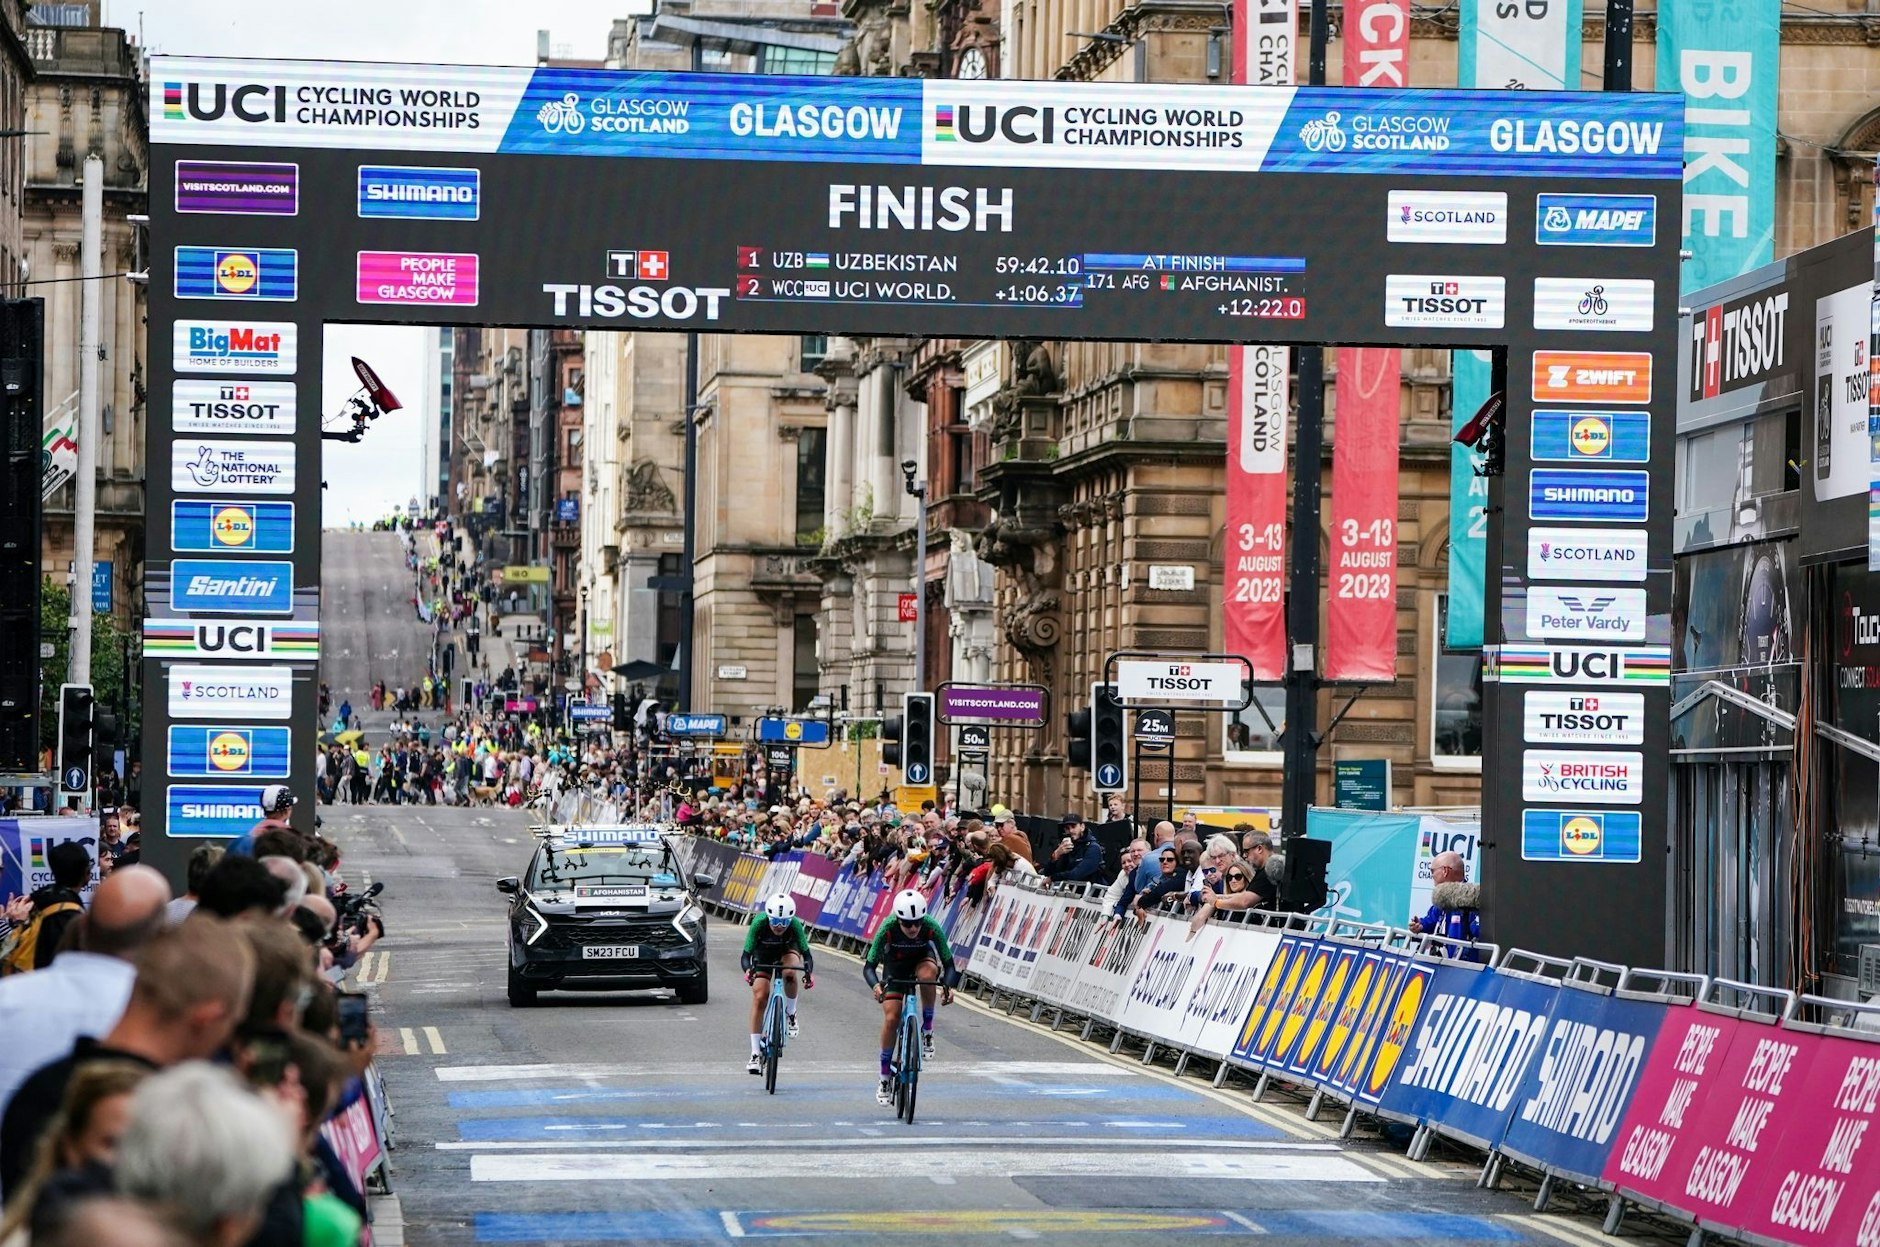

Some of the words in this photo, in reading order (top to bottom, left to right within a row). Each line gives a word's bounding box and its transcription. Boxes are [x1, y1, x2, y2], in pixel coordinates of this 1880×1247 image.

[188, 84, 285, 122] UCI
[297, 86, 392, 106] CYCLING
[401, 90, 480, 108] WORLD
[591, 98, 689, 117] GLASGOW
[1064, 108, 1158, 125] CYCLING
[1165, 110, 1244, 126] WORLD
[297, 107, 480, 129] CHAMPIONSHIPS
[590, 116, 689, 134] SCOTLAND
[730, 103, 902, 140] GLASGOW
[958, 106, 1054, 144] UCI
[1353, 115, 1450, 134] GLASGOW
[1064, 128, 1243, 148] CHAMPIONSHIPS
[1352, 133, 1450, 151] SCOTLAND
[1490, 120, 1664, 155] GLASGOW
[1681, 50, 1752, 238] BIKE
[182, 182, 290, 194] VISITSCOTLAND.COM
[367, 184, 473, 204] SHIMANO
[828, 184, 1012, 232] FINISH
[1414, 210, 1496, 224] SCOTLAND
[1575, 210, 1642, 230] MAPEI
[400, 257, 456, 272] PEOPLE
[749, 252, 760, 268] 1
[773, 252, 803, 270] UZB
[836, 253, 957, 272] UZBEKISTAN
[996, 256, 1080, 275] 59:42.10
[1142, 255, 1168, 270] AT
[1172, 256, 1226, 272] FINISH
[412, 272, 456, 286] MAKE
[1087, 274, 1116, 289] 171
[1122, 274, 1150, 290] AFG
[1181, 275, 1288, 292] AFGHANIST.
[378, 286, 455, 300] GLASGOW
[748, 280, 760, 296] 2
[772, 280, 803, 297] WCC
[836, 280, 870, 299] UCI
[876, 282, 956, 300] WORLD.
[996, 284, 1079, 302] +1:06.37
[543, 284, 730, 320] TISSOT
[1218, 299, 1301, 318] +12:22.0
[1402, 298, 1487, 314] TISSOT
[190, 328, 280, 356] BigMat
[1724, 292, 1788, 382] TISSOT
[234, 360, 278, 368] BUILDERS
[1576, 369, 1636, 386] ZWIFT
[1252, 347, 1268, 452] COTLAND
[1270, 345, 1282, 452] LASGOW
[190, 404, 280, 420] TISSOT
[221, 452, 244, 460] THE
[222, 464, 281, 473] NATIONAL
[222, 474, 274, 484] LOTTERY
[1544, 488, 1634, 503] SHIMANO
[1239, 524, 1282, 551] 3-13
[1342, 518, 1392, 546] 3-13
[1237, 556, 1282, 572] AUGUST
[1340, 552, 1392, 568] AUGUST
[1554, 548, 1636, 561] SCOTLAND
[186, 575, 278, 598] Santini
[1235, 578, 1280, 602] 2023
[1339, 574, 1390, 599] 2023
[1542, 614, 1582, 628] Peter
[1586, 616, 1630, 632] Vardy
[199, 626, 264, 652] UCI
[1554, 652, 1618, 678] UCI
[196, 686, 278, 699] SCOTLAND
[1147, 678, 1212, 690] TISSOT
[949, 698, 1038, 709] VISITSCOTLAND.COM
[688, 719, 720, 729] MAPEI
[1142, 719, 1168, 732] 25M
[1540, 714, 1628, 730] TISSOT
[1560, 764, 1628, 778] BRITISH
[1560, 778, 1628, 791] CYCLING
[564, 830, 660, 842] SHIMANO
[1432, 832, 1474, 860] UCI
[1057, 907, 1102, 962] TISSOT
[587, 948, 612, 957] SM23
[616, 948, 635, 957] FCU
[1137, 950, 1195, 1011] SCOTLAND
[1194, 962, 1258, 1026] SCOTLAND
[1400, 994, 1546, 1112] SHIMANO
[1674, 1024, 1720, 1075] PEOPLE
[1742, 1039, 1798, 1096] PEOPLE
[1522, 1020, 1646, 1144] SHIMANO
[1659, 1078, 1698, 1129] MAKE
[1726, 1096, 1774, 1152] MAKE
[1620, 1124, 1676, 1182] GLASGOW
[1819, 1117, 1870, 1174] MAKE
[1685, 1146, 1750, 1208] GLASGOW
[1771, 1170, 1846, 1234] GLASGOW
